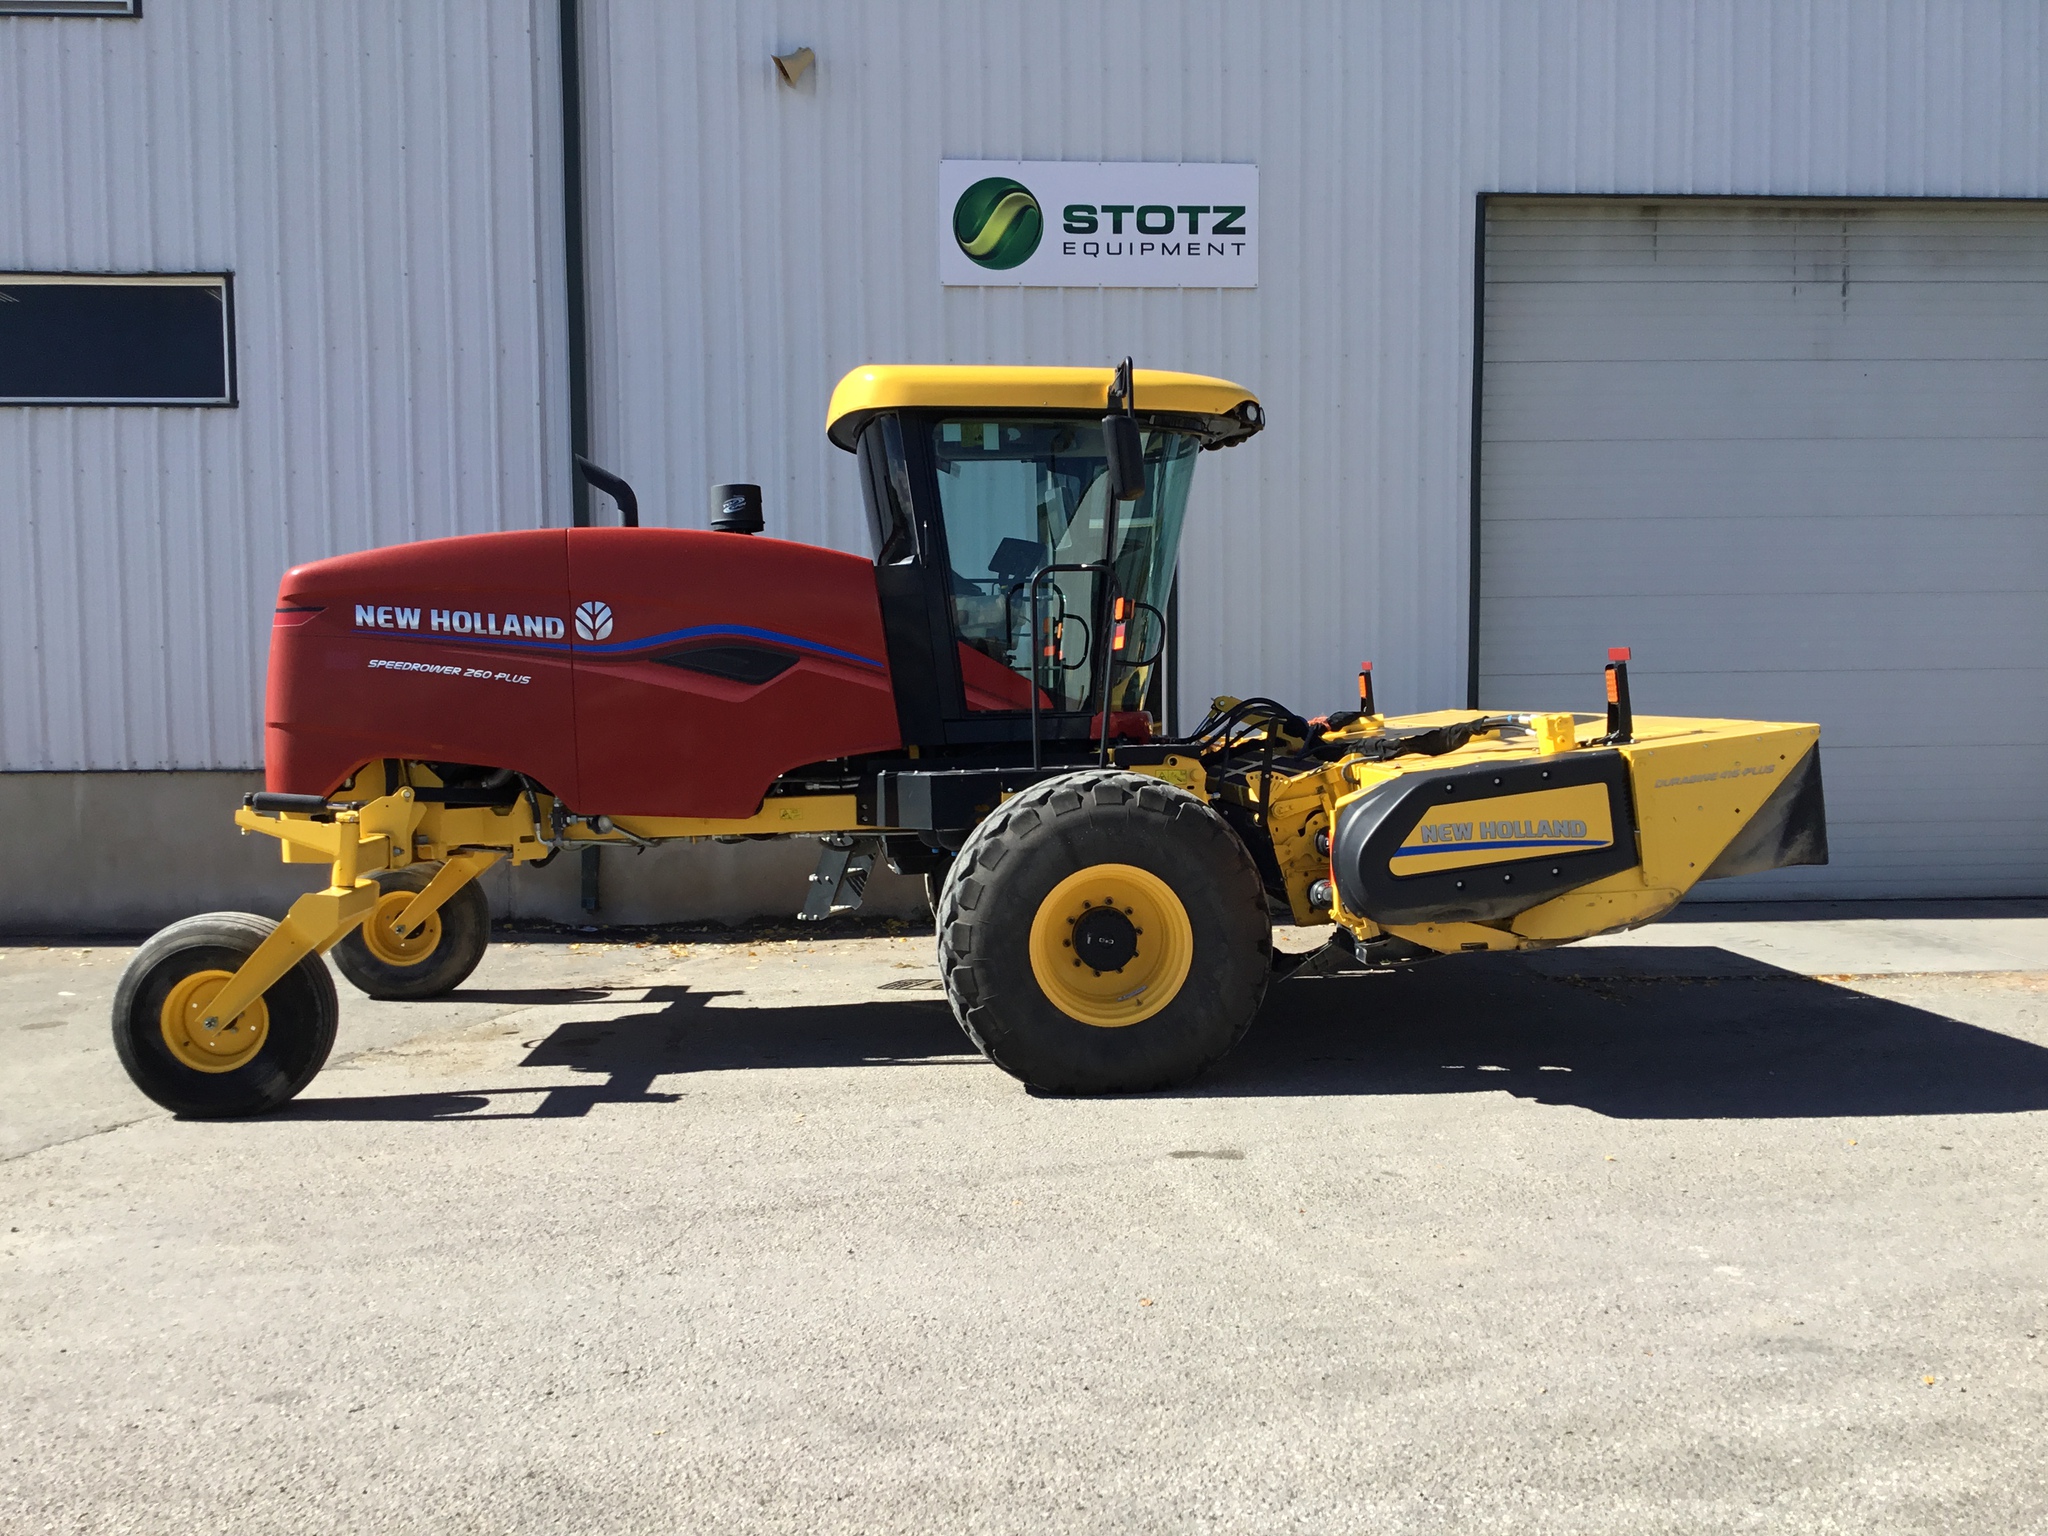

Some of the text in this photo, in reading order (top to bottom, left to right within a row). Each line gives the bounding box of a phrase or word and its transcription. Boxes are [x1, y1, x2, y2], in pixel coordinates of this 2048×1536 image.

[1063, 204, 1246, 235] STOTZ
[1063, 241, 1246, 258] EQUIPMENT
[355, 604, 565, 639] NEW HOLLAND
[367, 659, 462, 676] SPEEDROWER
[463, 668, 493, 679] 260
[1420, 819, 1587, 843] NEW HOLLAND
